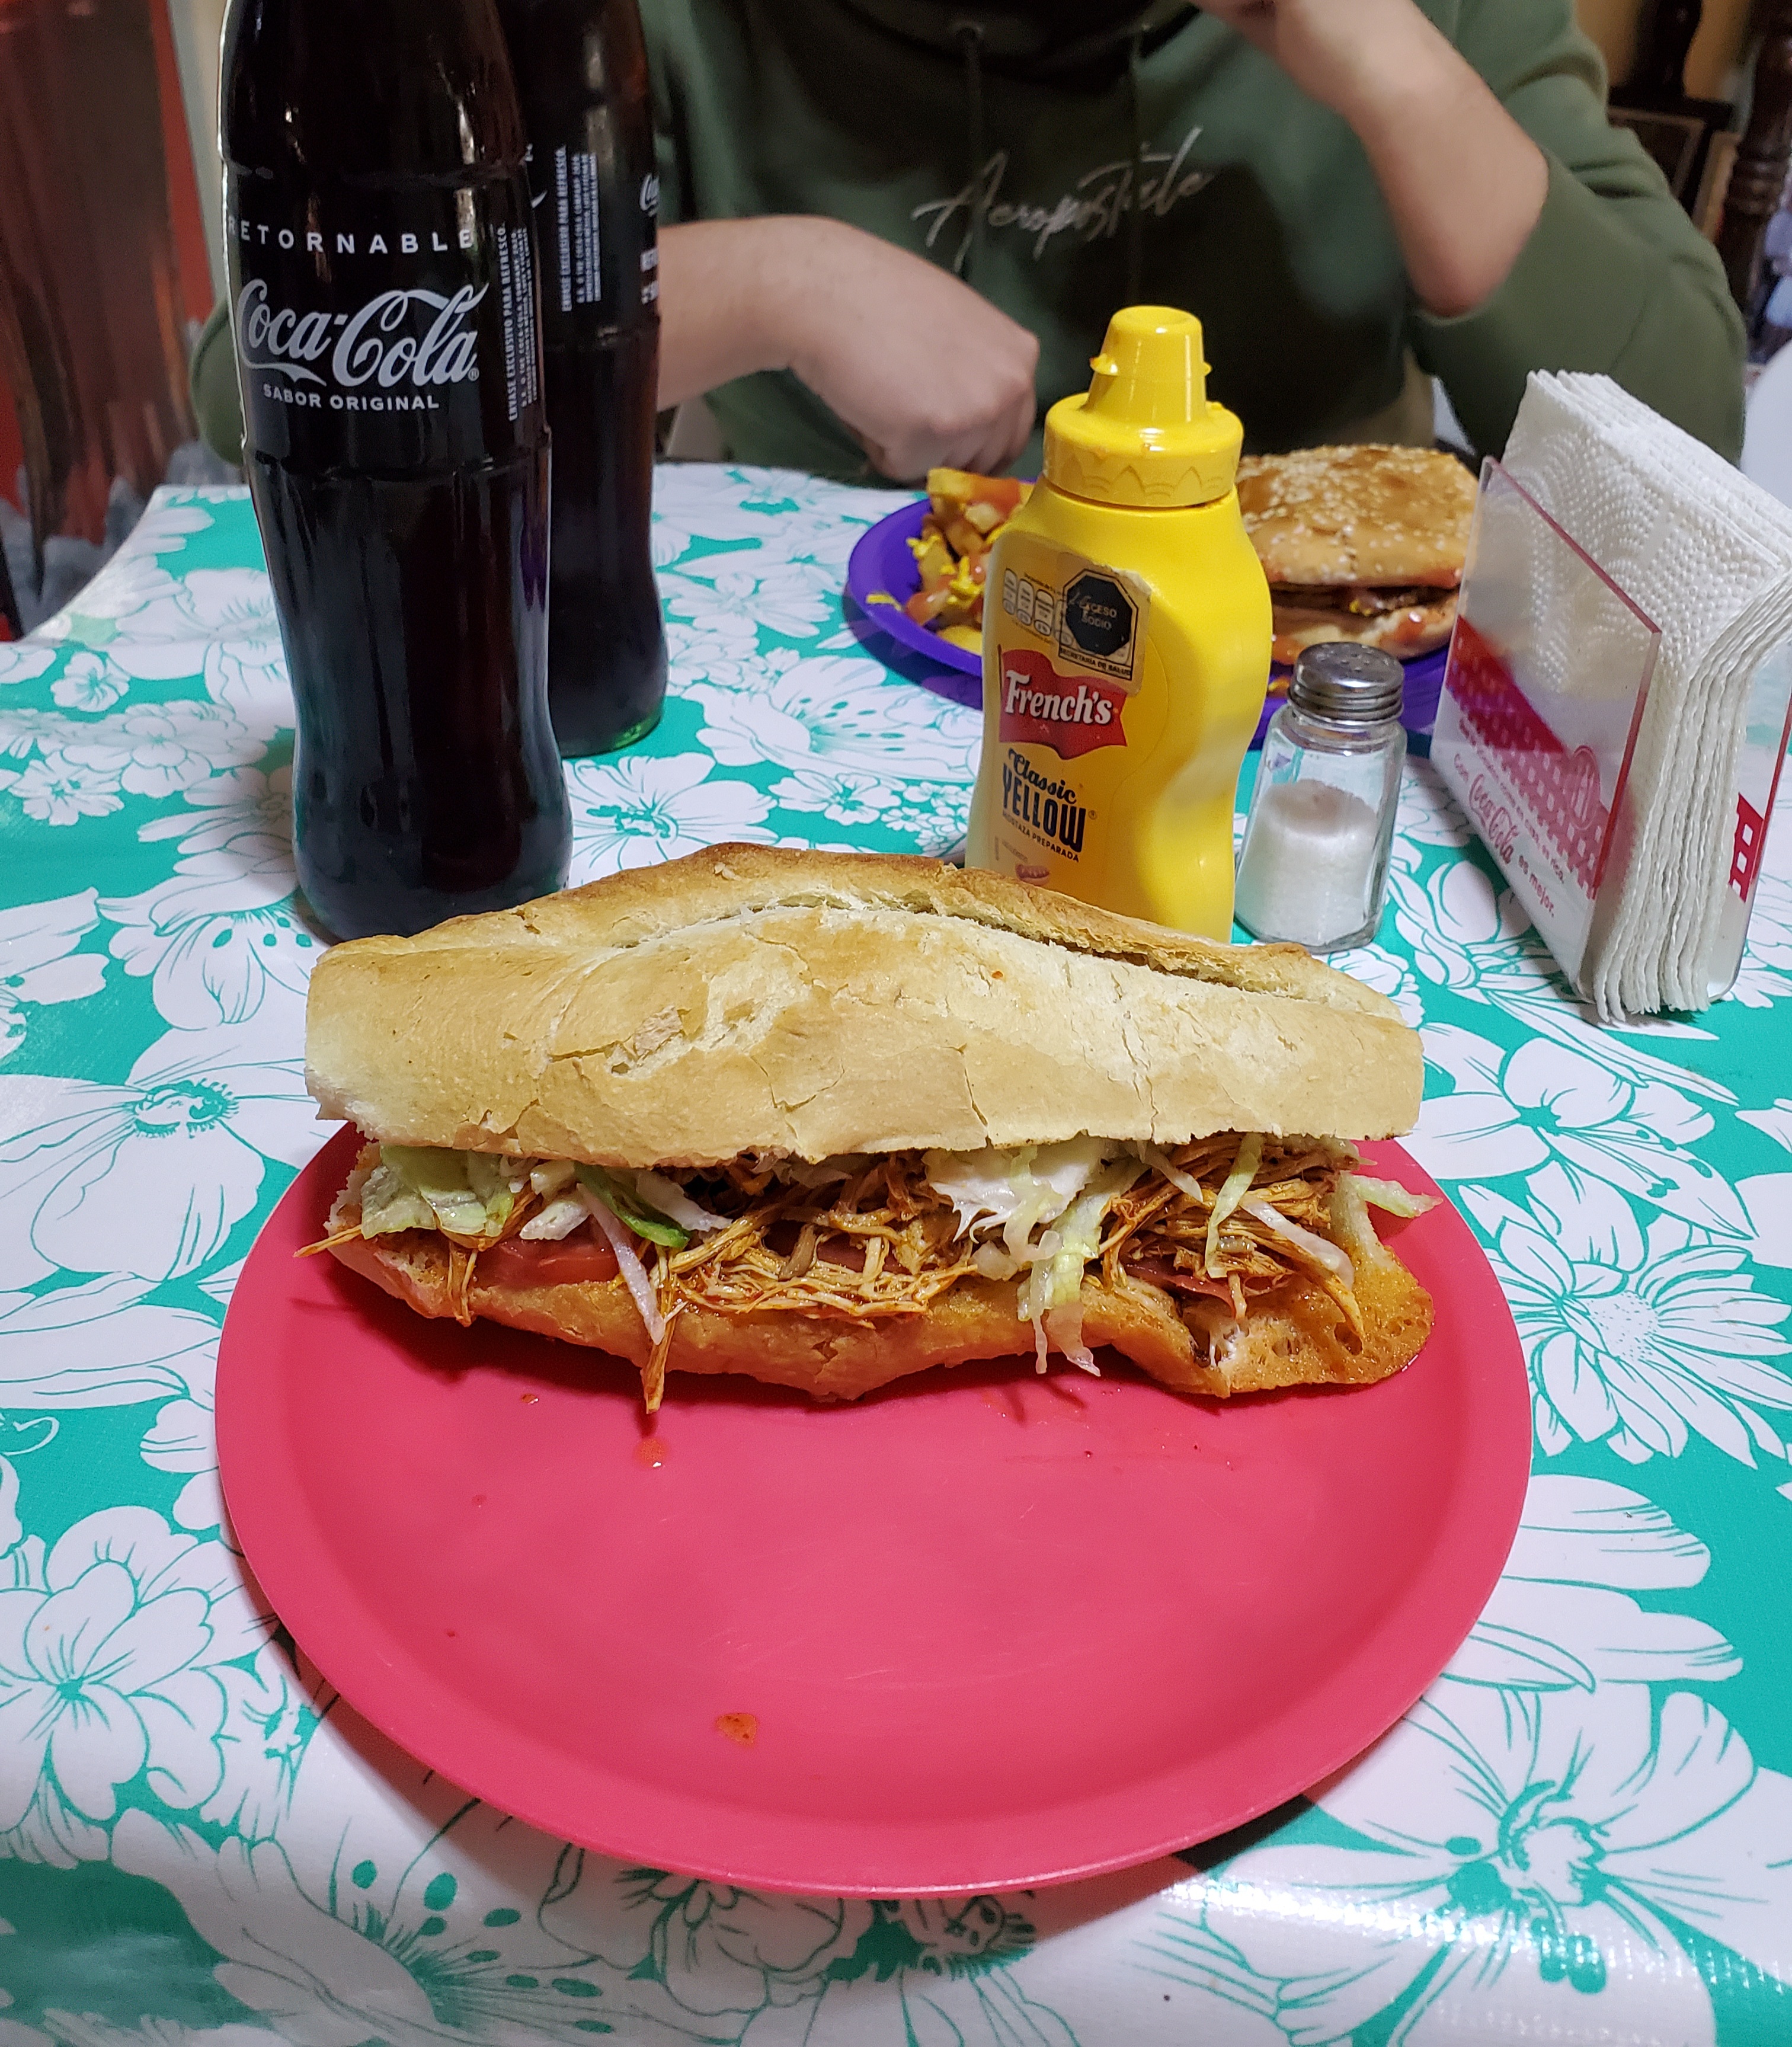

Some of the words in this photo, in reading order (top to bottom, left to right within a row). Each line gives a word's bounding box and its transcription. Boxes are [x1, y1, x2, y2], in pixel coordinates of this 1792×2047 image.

[238, 278, 489, 387] Coca-Cola
[263, 383, 322, 408] SABOR
[329, 394, 439, 411] ORIGINAL
[1006, 670, 1112, 724] French's
[1008, 747, 1077, 804] Classic
[1003, 763, 1086, 853] YELLOW
[1032, 831, 1079, 862] PREPARADA
